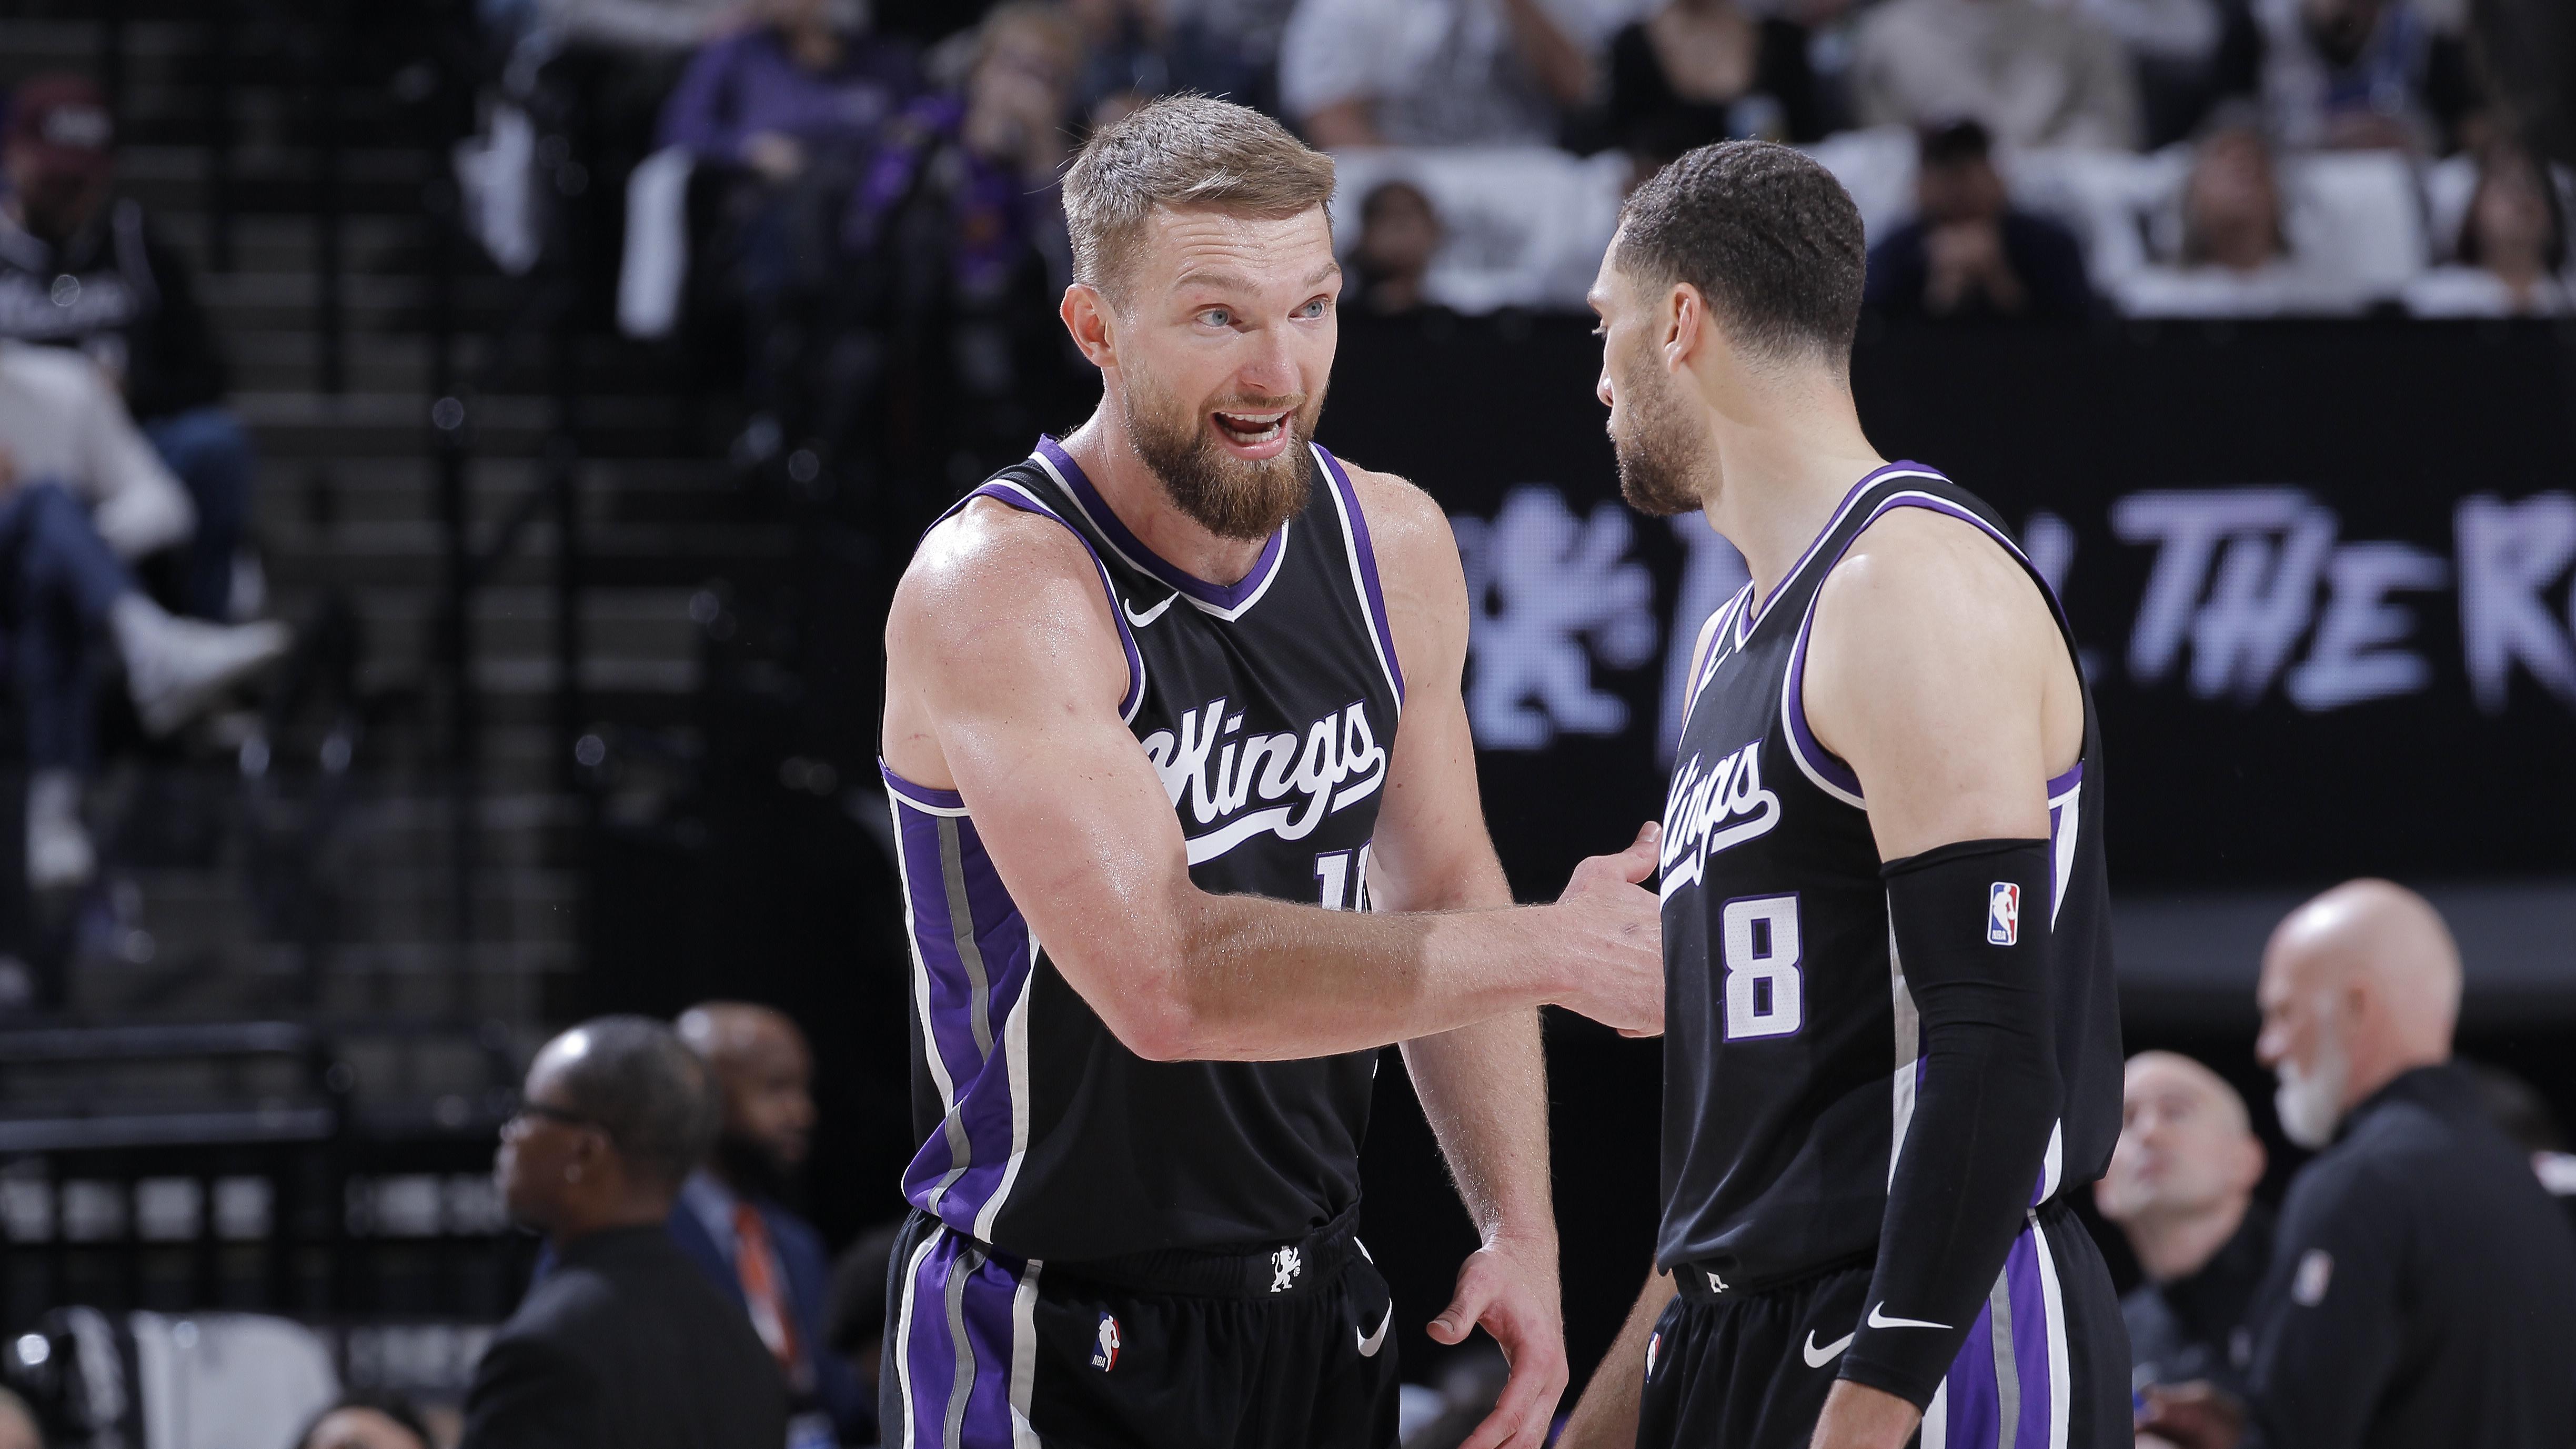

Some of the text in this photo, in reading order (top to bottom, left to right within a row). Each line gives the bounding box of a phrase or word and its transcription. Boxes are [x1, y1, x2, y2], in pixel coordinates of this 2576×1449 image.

[2109, 483, 2452, 711] THE
[1140, 696, 1387, 867] Kings
[1719, 891, 1805, 1043] 8
[1092, 1354, 1106, 1368] NBA
